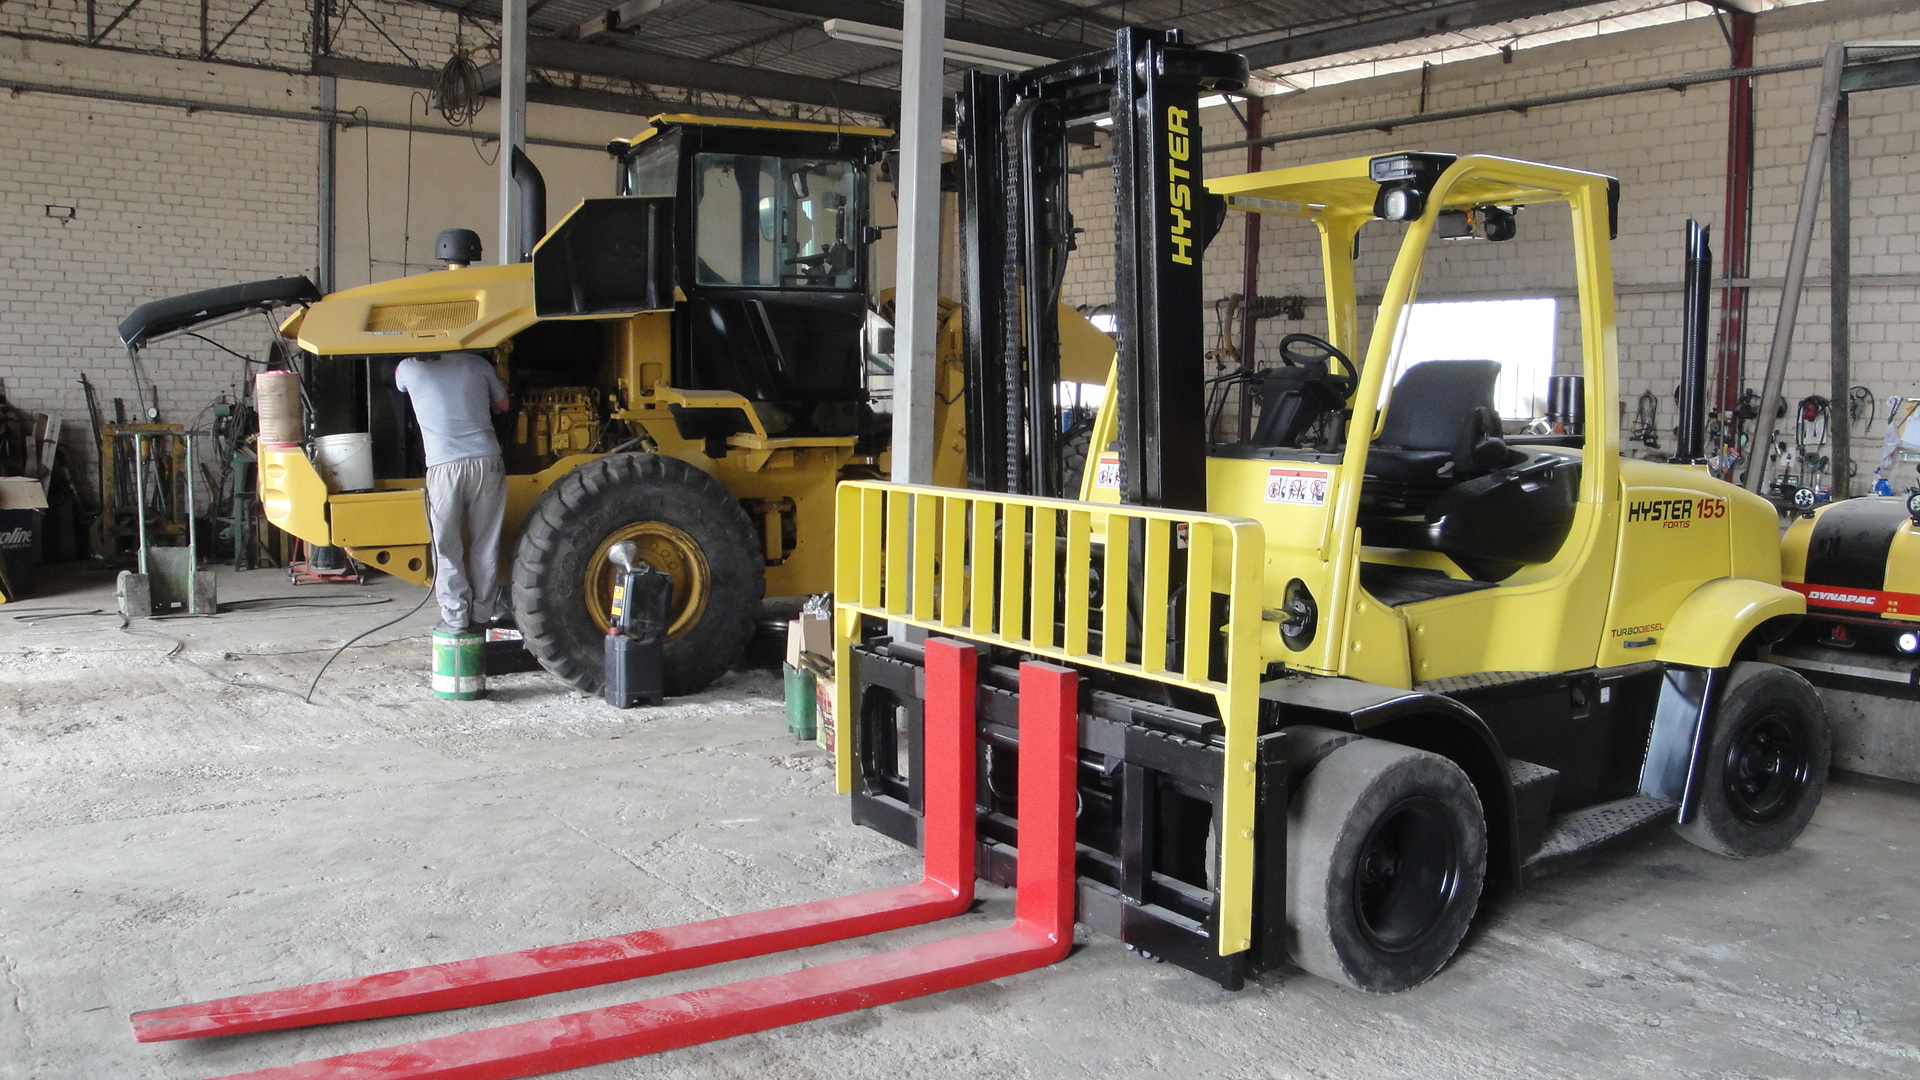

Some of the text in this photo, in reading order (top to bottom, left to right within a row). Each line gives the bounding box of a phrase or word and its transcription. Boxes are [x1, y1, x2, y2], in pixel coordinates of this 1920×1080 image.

[1167, 105, 1193, 266] HYSTER
[1628, 498, 1726, 522] HYSTER 155
[1662, 520, 1690, 529] FORTIS
[0, 527, 32, 545] oline
[1808, 591, 1876, 605] DYNAPAC
